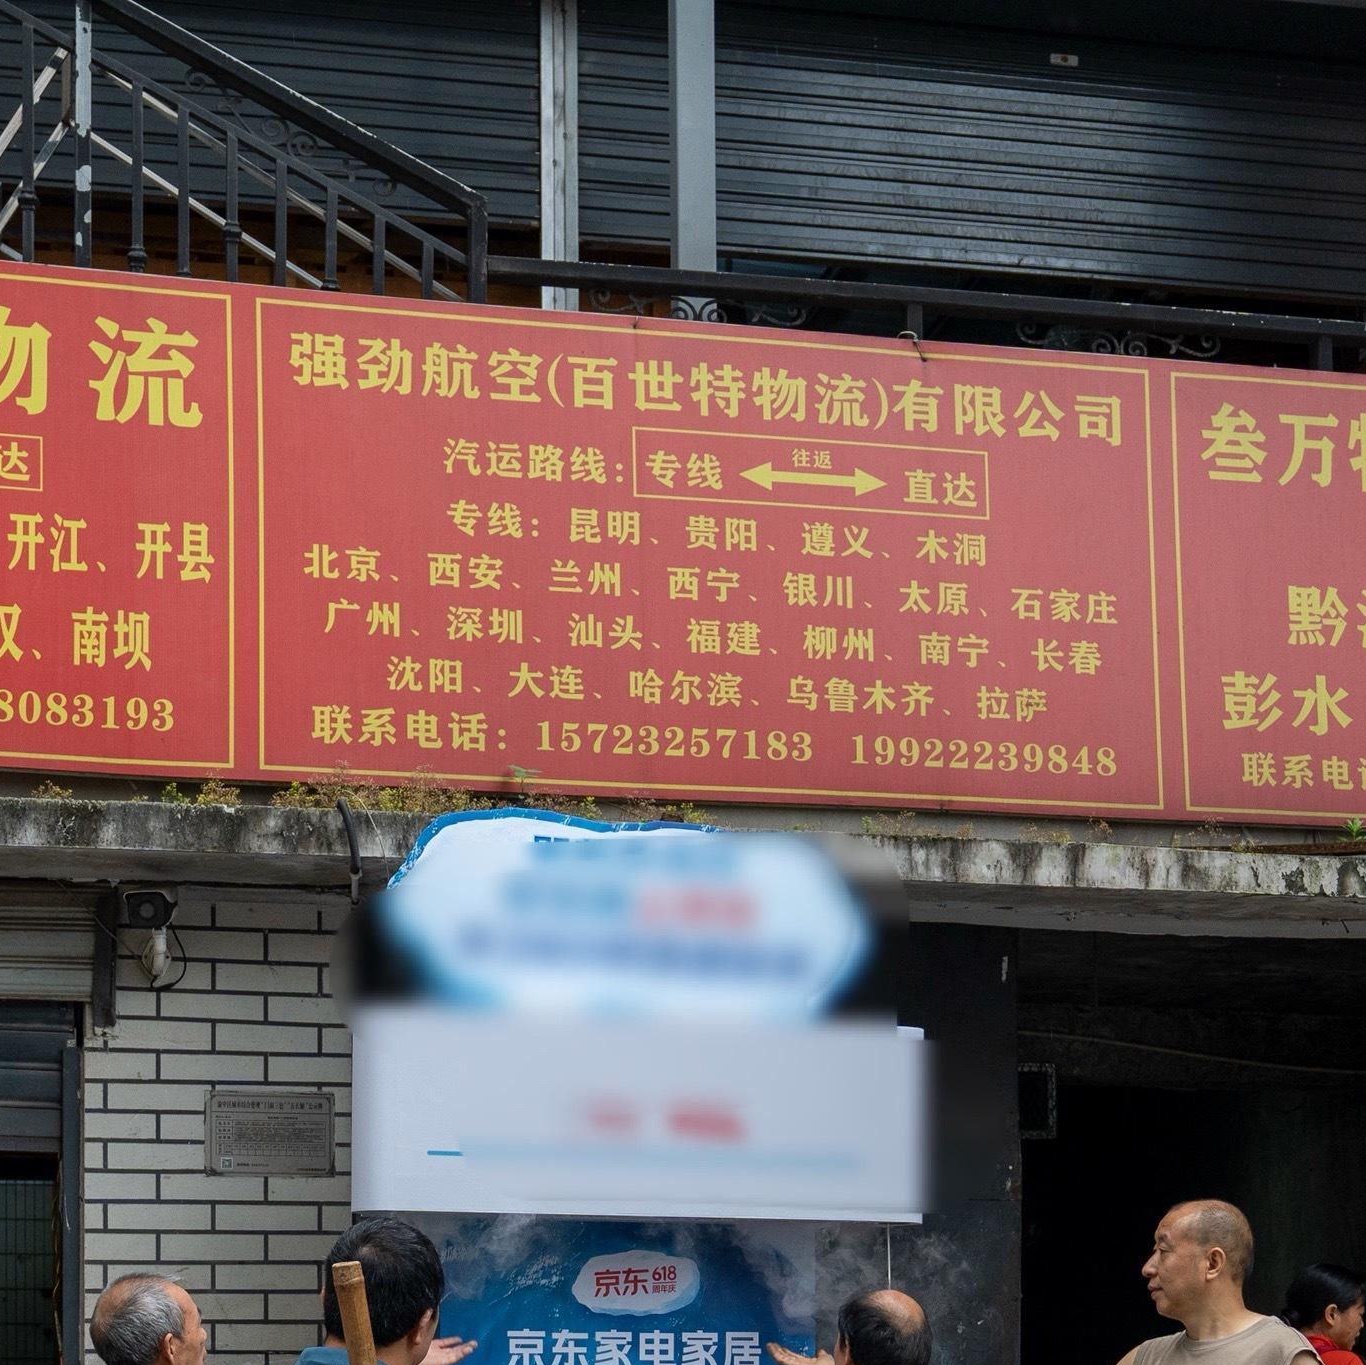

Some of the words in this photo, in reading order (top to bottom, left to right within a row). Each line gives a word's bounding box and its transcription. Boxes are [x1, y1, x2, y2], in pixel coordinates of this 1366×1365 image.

[792, 451, 830, 468] 往返
[646, 452, 722, 490] 专线
[903, 471, 975, 507] 直达
[852, 735, 1116, 774] 19922239848
[595, 1267, 649, 1297] 京东
[652, 1265, 677, 1281] 618
[652, 1284, 677, 1295] 周年庆
